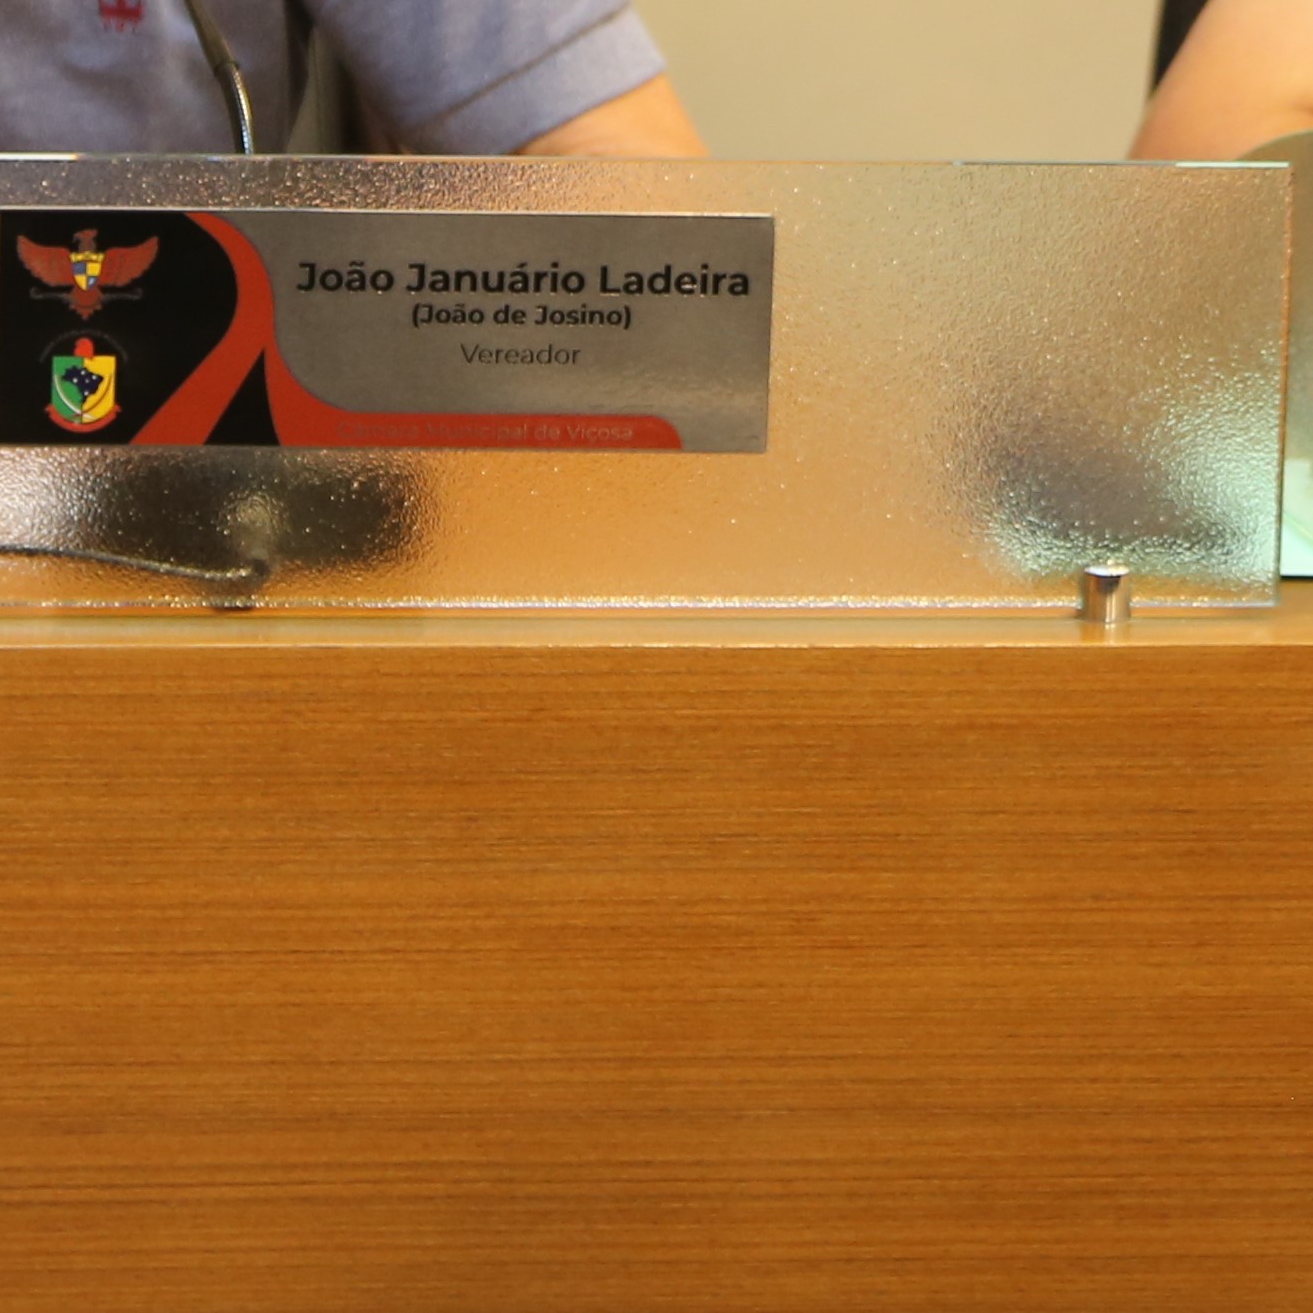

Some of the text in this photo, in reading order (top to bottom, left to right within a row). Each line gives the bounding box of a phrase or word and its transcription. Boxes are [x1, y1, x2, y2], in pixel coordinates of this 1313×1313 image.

[297, 261, 750, 296] João Januário Ladeira
[412, 303, 632, 329] (João de Josino)
[460, 343, 581, 365] Vereador
[534, 422, 560, 440] de
[566, 423, 634, 443] Viçosa
